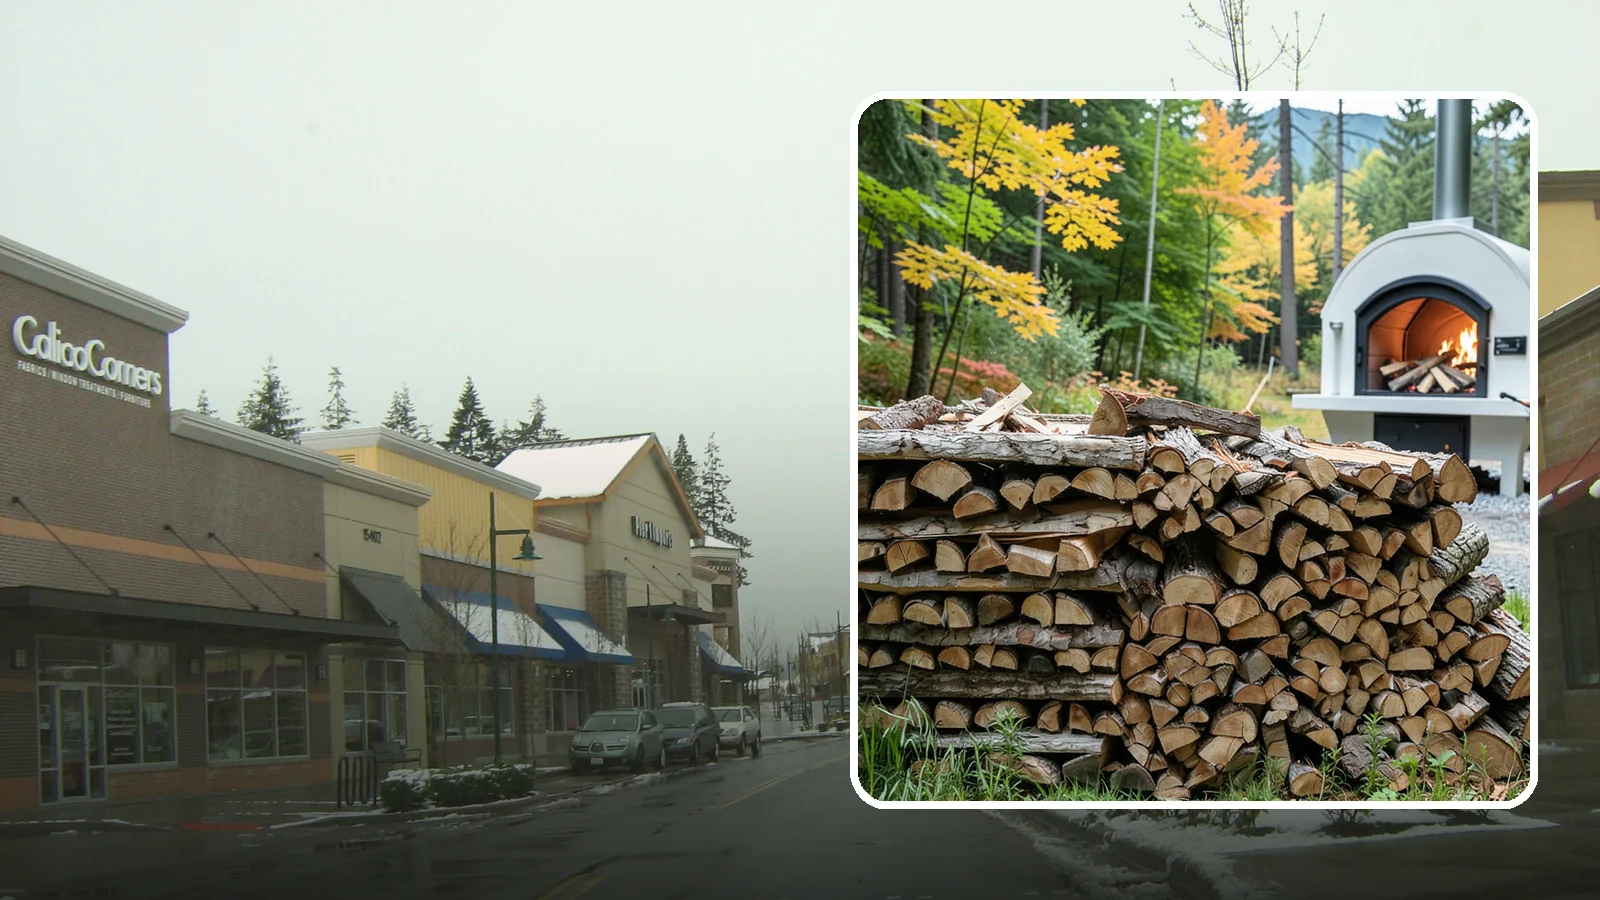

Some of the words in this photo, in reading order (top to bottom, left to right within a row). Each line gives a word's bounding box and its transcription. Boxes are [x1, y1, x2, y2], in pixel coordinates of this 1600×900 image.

[16, 360, 47, 377] FABRICS
[51, 370, 78, 387] WINDOW
[78, 378, 116, 398] TREATMENTS
